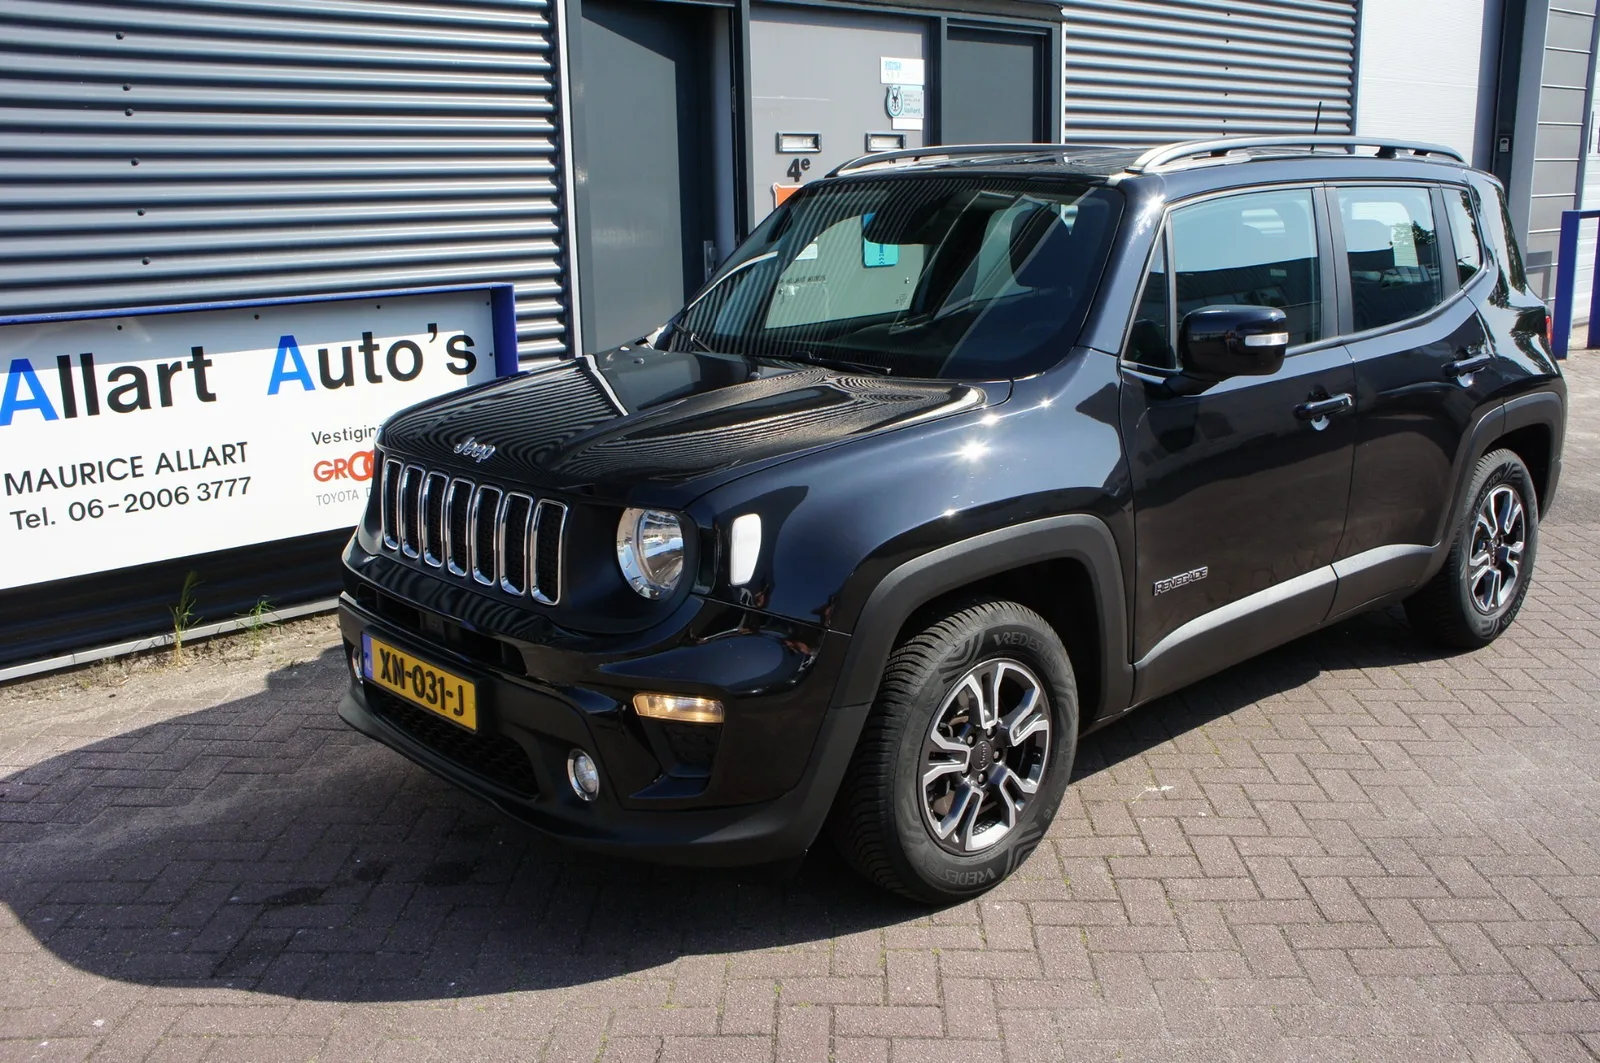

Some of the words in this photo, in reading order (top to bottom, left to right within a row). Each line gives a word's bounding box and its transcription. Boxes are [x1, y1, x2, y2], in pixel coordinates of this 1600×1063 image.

[787, 158, 811, 183] 4e
[0, 345, 217, 426] Allart
[267, 322, 478, 396] Auto's
[311, 424, 382, 445] Vestigin
[453, 436, 496, 463] Jeep
[4, 455, 145, 496] MAURICE
[155, 441, 248, 475] ALLART
[9, 507, 56, 530] Tel.
[197, 476, 251, 502] 3777
[316, 489, 360, 506] TOYOTA
[1152, 566, 1208, 596] RENEGADE
[379, 647, 465, 717] XN-031-J
